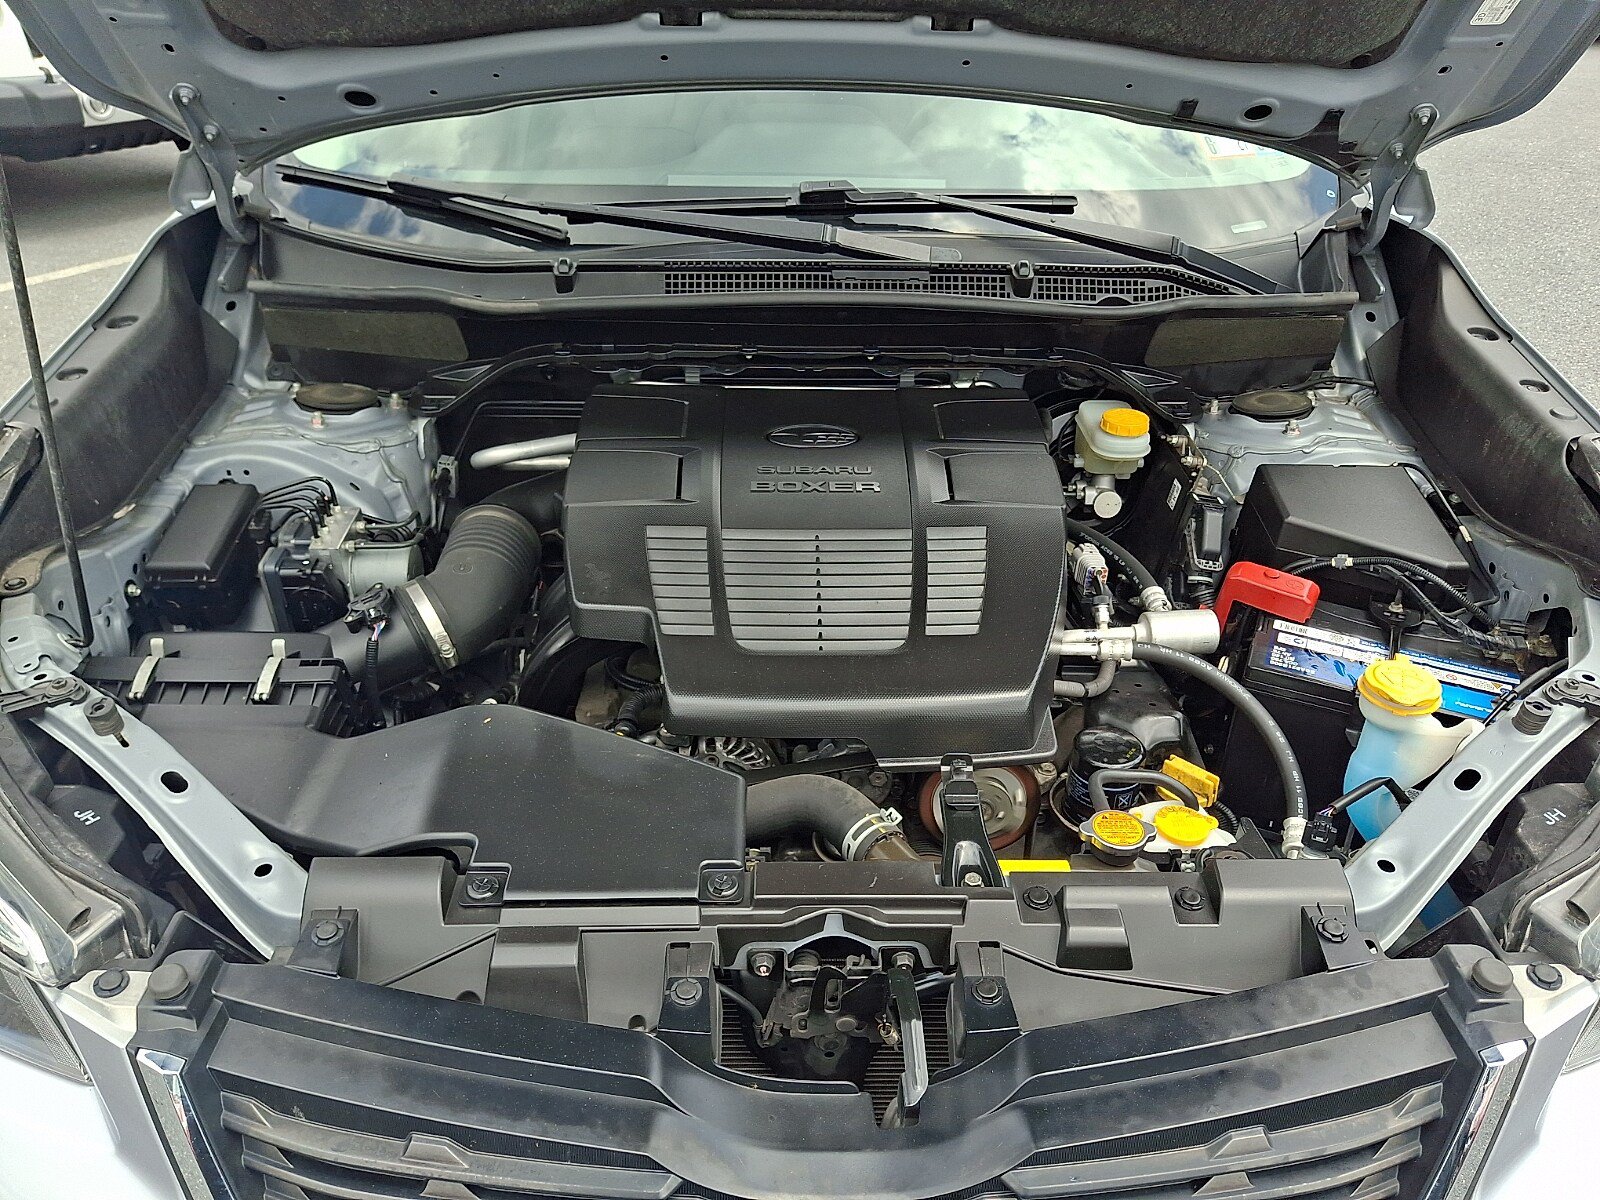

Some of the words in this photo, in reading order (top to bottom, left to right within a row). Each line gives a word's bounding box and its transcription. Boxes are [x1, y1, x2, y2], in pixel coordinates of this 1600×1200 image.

[756, 464, 873, 475] SUBARU
[749, 480, 882, 493] BOXER
[73, 809, 101, 826] JH
[1543, 807, 1567, 826] JH
